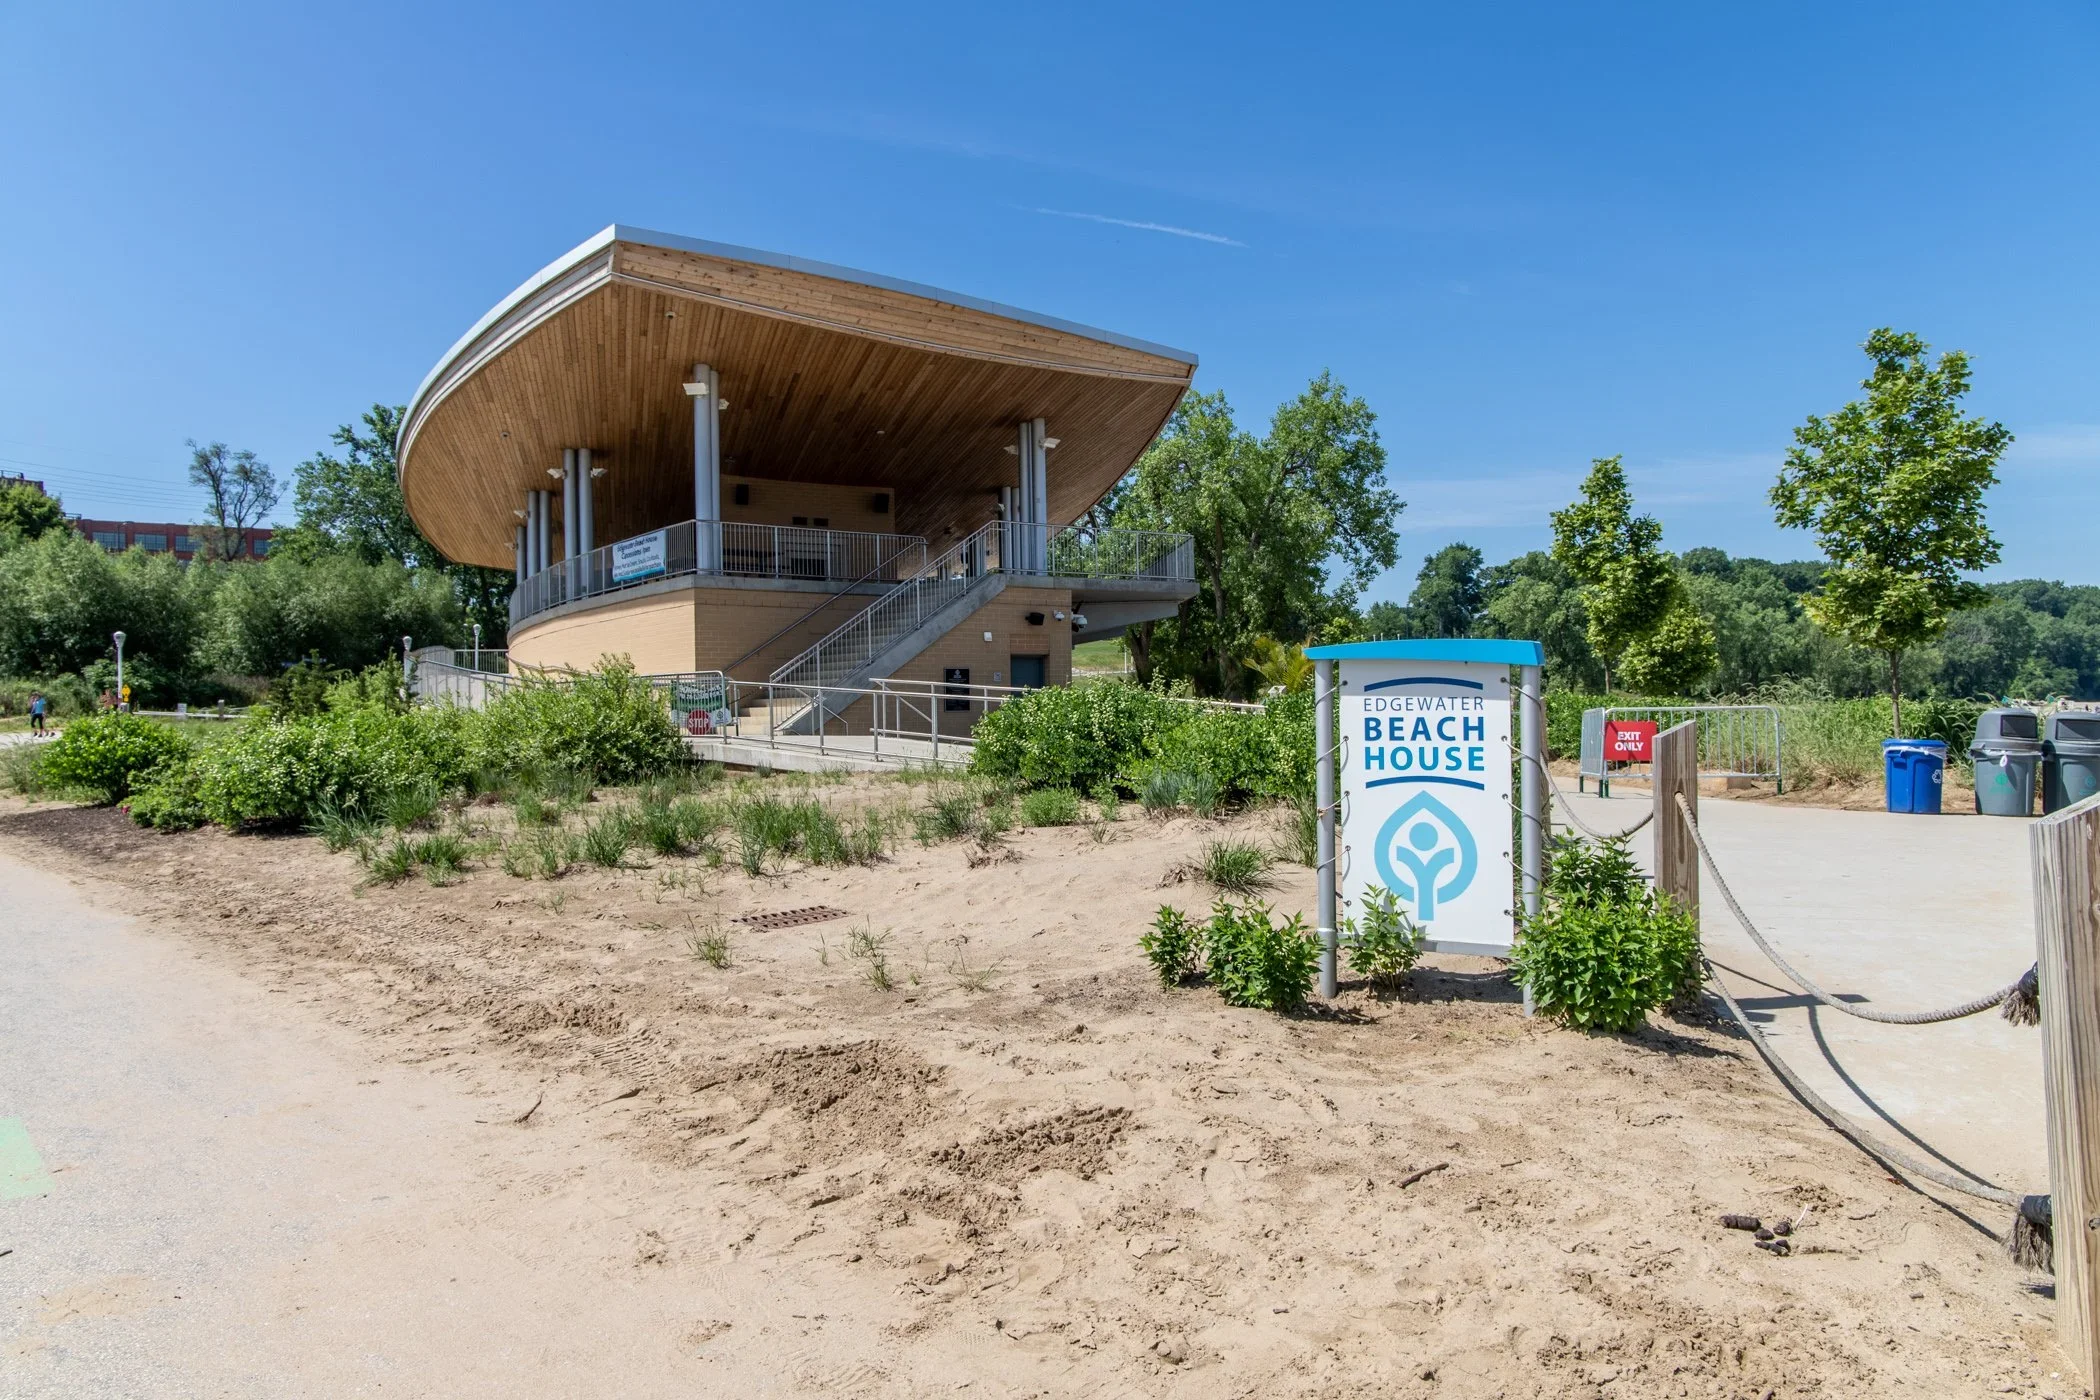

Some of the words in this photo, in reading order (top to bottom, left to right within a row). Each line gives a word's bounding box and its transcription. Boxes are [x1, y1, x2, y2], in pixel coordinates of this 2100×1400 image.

[1363, 696, 1484, 712] EDGEWATER
[688, 718, 709, 728] STOP
[1364, 716, 1485, 742] BEACH
[1617, 731, 1642, 741] EXIT
[1614, 741, 1645, 752] ONLY
[1364, 746, 1485, 771] HOUSE
